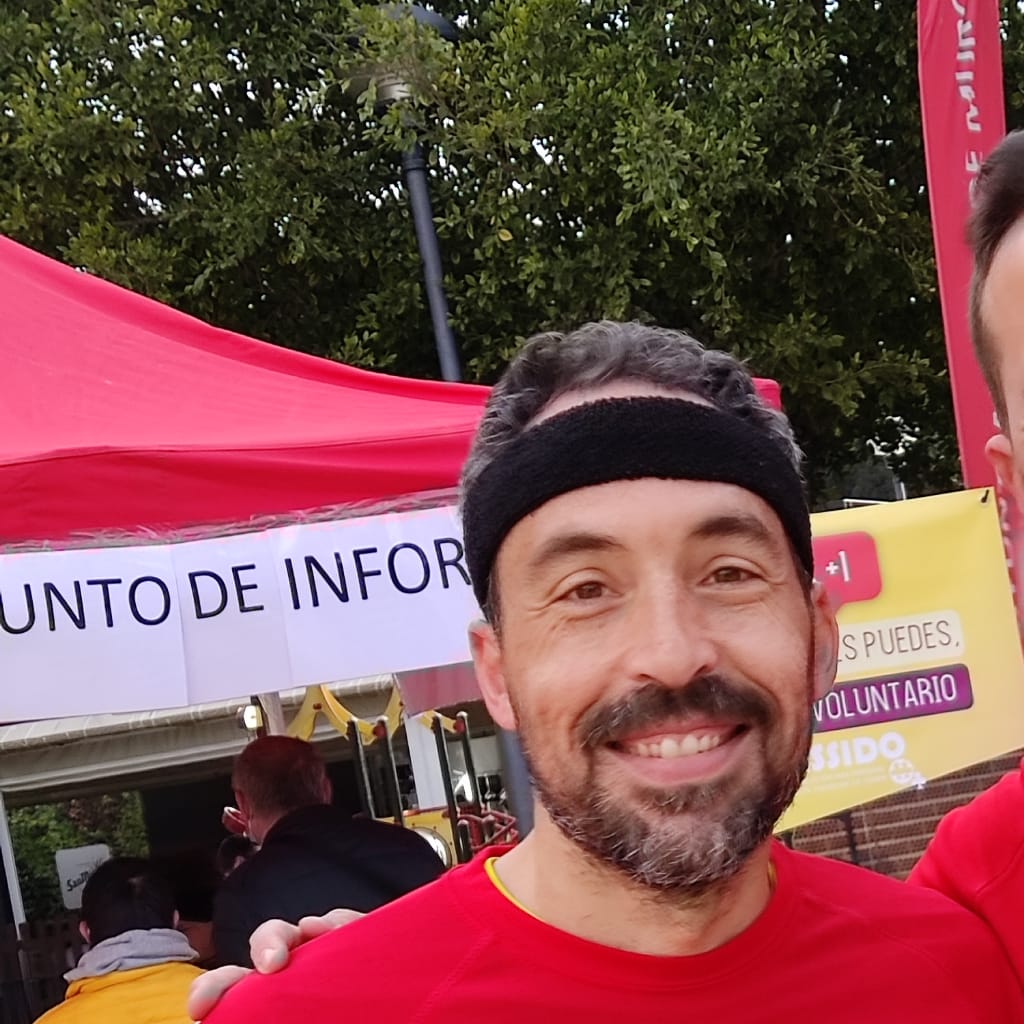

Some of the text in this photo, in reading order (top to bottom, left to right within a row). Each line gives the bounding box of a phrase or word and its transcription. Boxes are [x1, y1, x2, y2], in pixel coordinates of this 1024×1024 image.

[188, 564, 265, 620] DE
[284, 537, 471, 611] INFOR
[863, 619, 960, 659] PUEDES,
[813, 673, 958, 722] VOLUNTARIO
